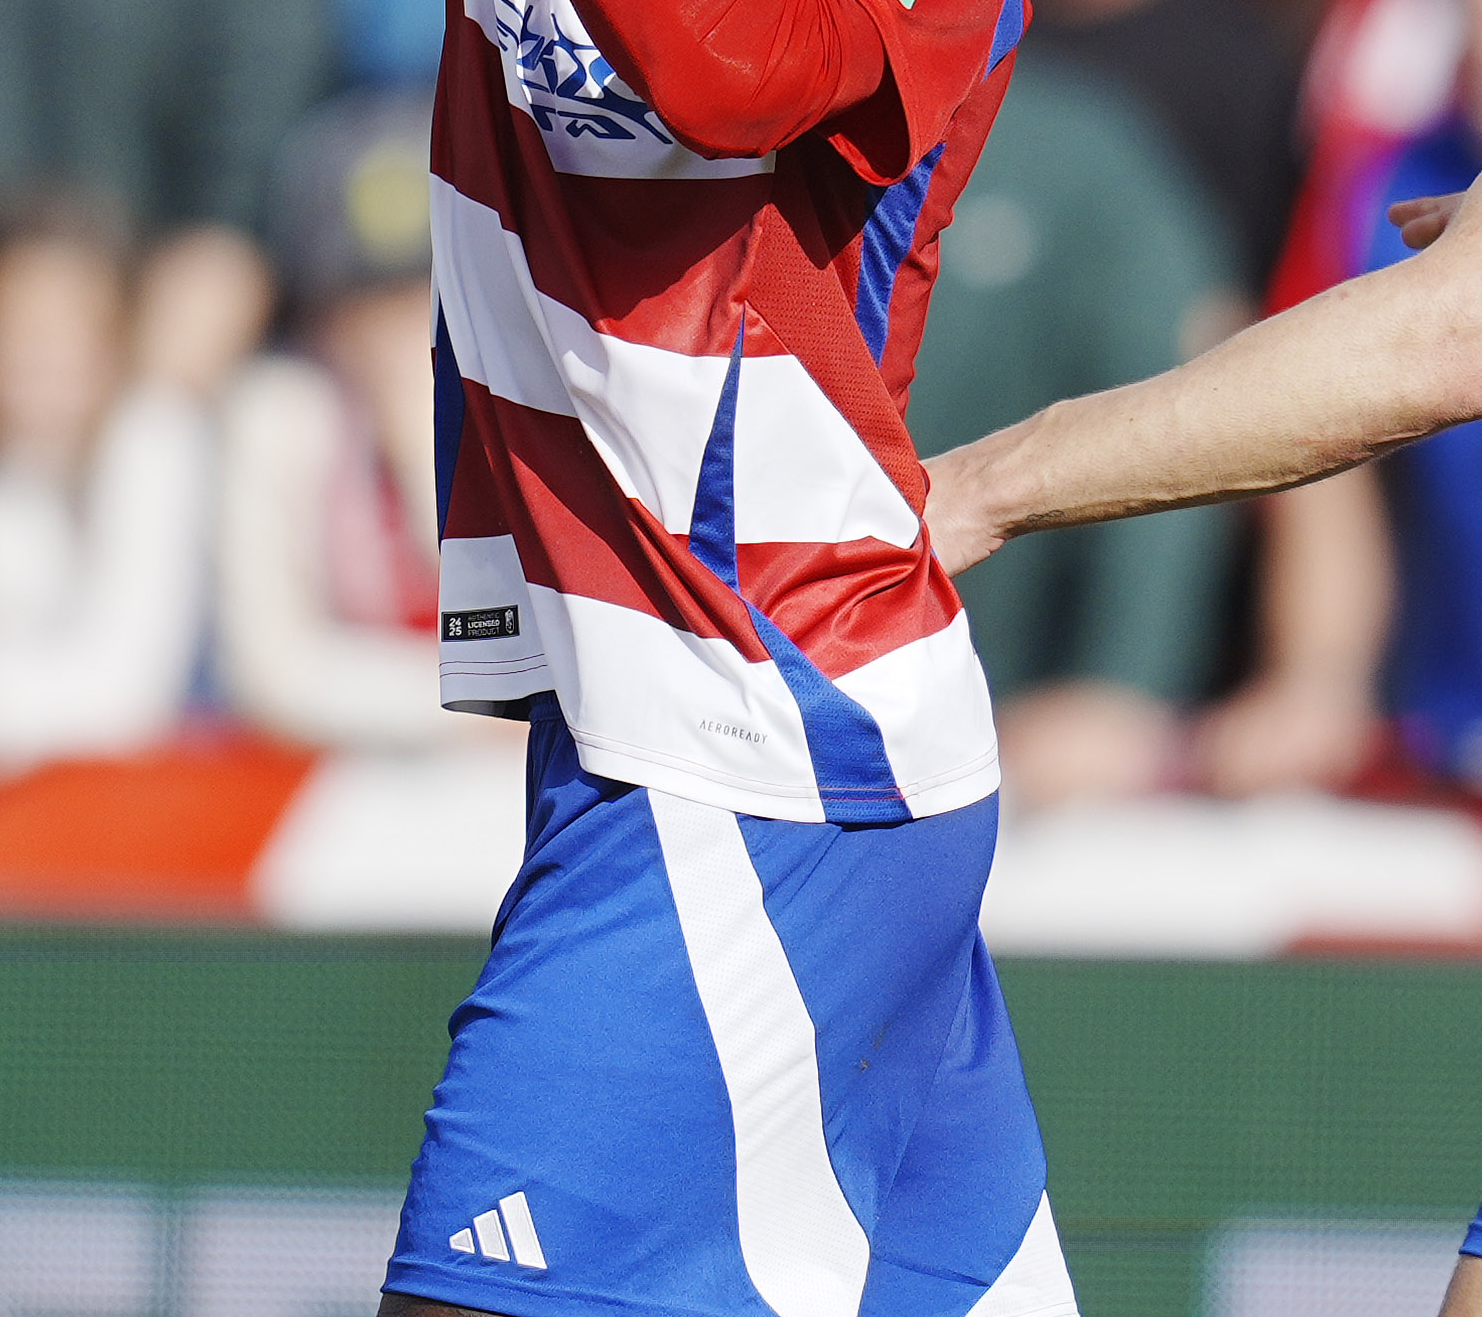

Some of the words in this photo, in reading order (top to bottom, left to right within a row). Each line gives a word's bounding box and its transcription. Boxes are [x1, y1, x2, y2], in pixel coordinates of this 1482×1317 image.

[448, 617, 462, 628] 24
[448, 626, 463, 637] 25
[699, 719, 768, 745] AEROREADY
